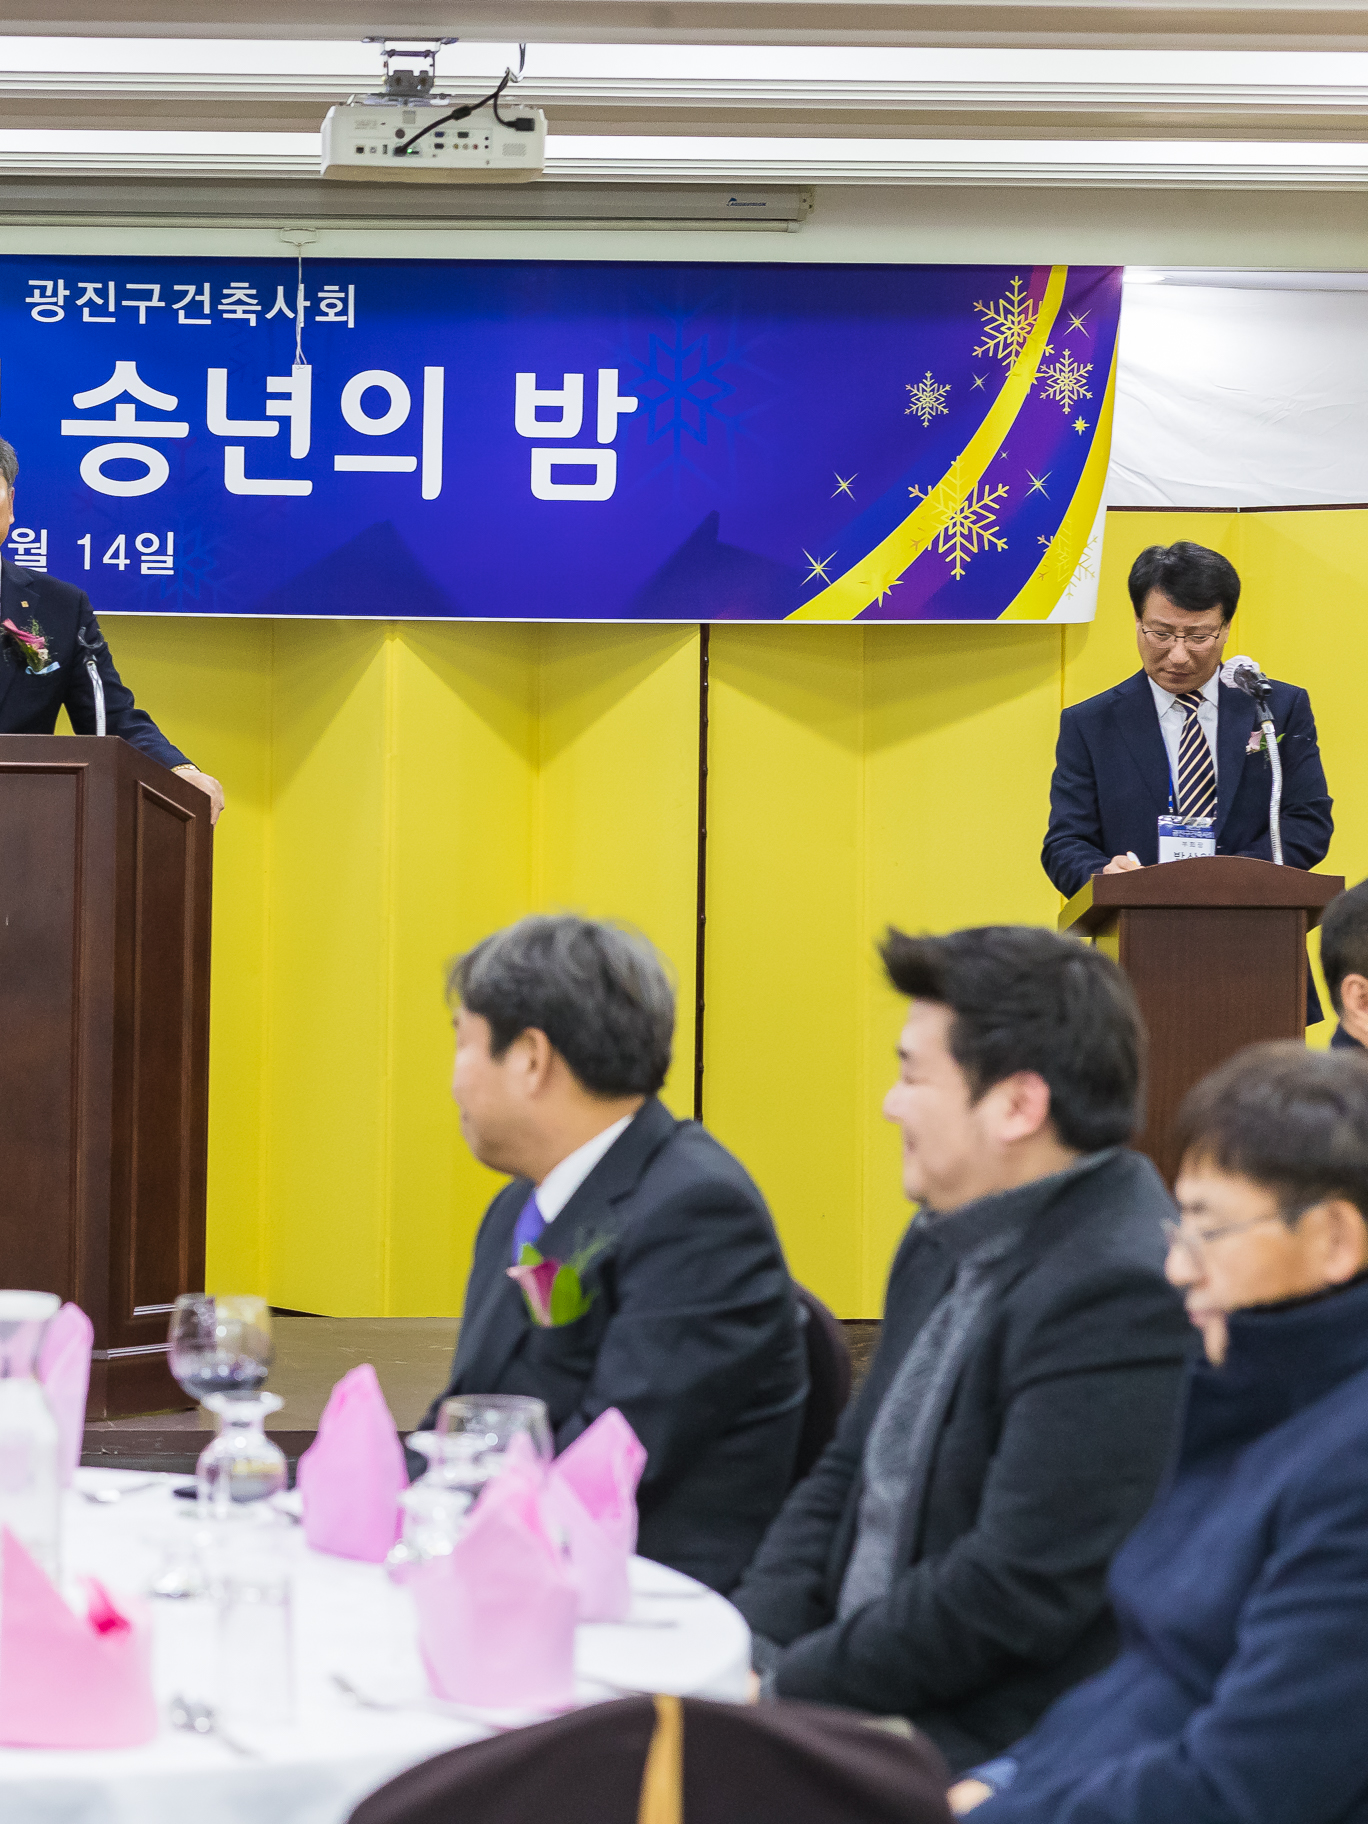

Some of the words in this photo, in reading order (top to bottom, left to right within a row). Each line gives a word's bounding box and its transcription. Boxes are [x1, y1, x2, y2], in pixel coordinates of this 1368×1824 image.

[25, 278, 356, 328] 광진구건축사회
[60, 360, 445, 500] 송년의
[514, 368, 639, 502] 밤
[76, 531, 176, 576] 14일
